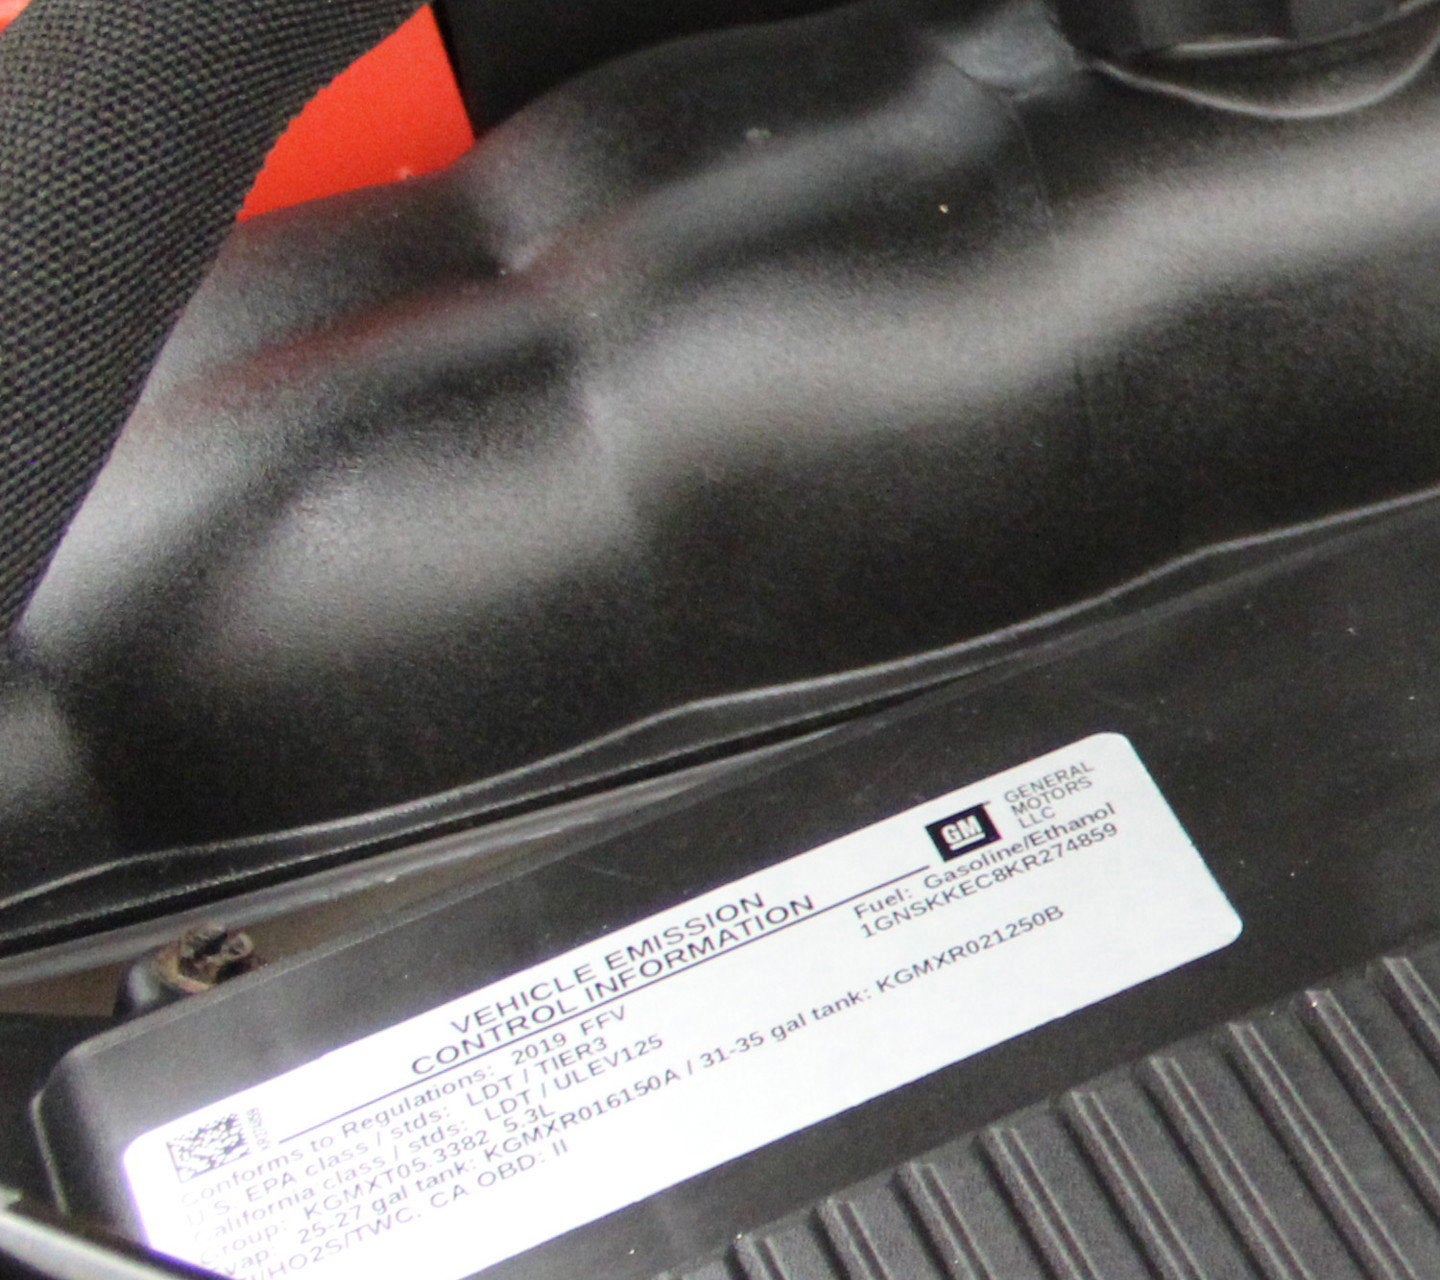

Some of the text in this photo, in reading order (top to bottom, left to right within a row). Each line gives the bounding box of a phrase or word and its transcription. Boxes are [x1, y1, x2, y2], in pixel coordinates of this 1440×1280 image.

[1003, 761, 1095, 804] GENERAL
[1010, 776, 1093, 817] MOTORS
[1018, 806, 1056, 829] LLC
[853, 801, 1116, 919] Fuel: Gasoline/Ethanol
[860, 822, 1119, 938] 1GNSKKEC8KR274859
[411, 894, 816, 1075] CONTROL INFORMATION
[451, 892, 765, 1035] VEHICLE EMISSION
[181, 1005, 626, 1209] Conforms to Regulations: 2019 FFV
[216, 1249, 276, 1277] vap:
[298, 1206, 363, 1244] 25-27
[371, 1186, 409, 1214] gal
[416, 1157, 476, 1192] tank:
[484, 1068, 680, 1162] KGMXR016150A
[700, 1030, 765, 1068] 31-35
[771, 1013, 807, 1041] gal
[810, 987, 871, 1021] tank:
[875, 905, 1065, 993] KGMXR021250B
[246, 1172, 297, 1203] EPA
[305, 1142, 369, 1177] class
[391, 1105, 450, 1138] stds:
[466, 1074, 513, 1107] LDT
[535, 1036, 608, 1075] TIER3
[322, 1155, 386, 1190] class
[409, 1121, 468, 1153] stds:
[484, 1090, 532, 1122] LDT
[553, 1034, 664, 1091] ULEV125
[303, 1130, 490, 1220] KGMXT05.3382
[503, 1105, 555, 1133] 5.3L
[430, 1184, 468, 1208] CA
[477, 1154, 546, 1187] OBD:
